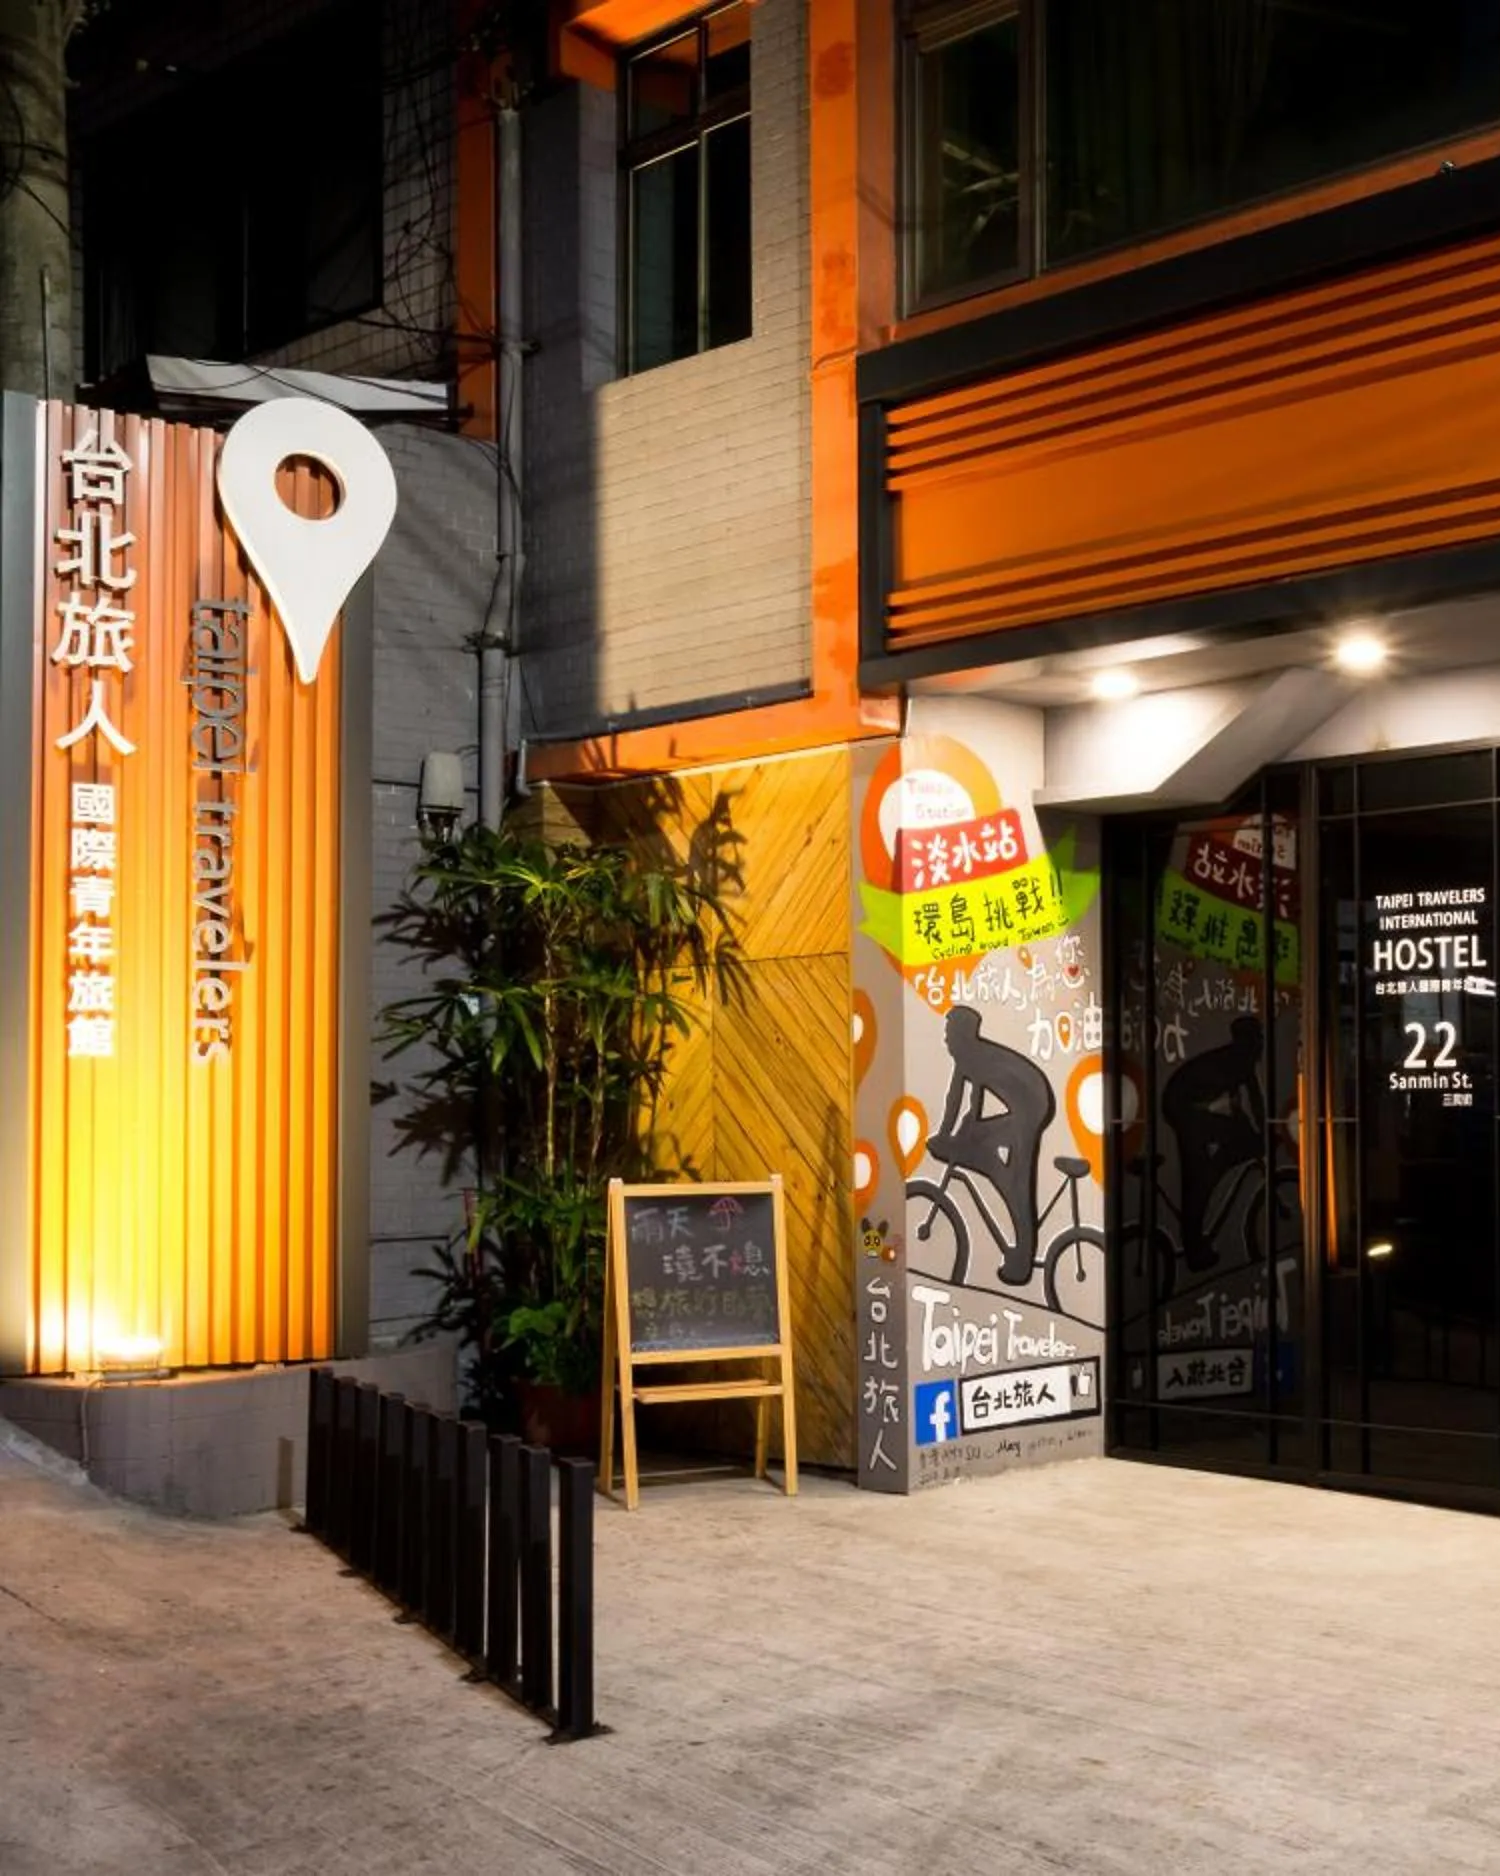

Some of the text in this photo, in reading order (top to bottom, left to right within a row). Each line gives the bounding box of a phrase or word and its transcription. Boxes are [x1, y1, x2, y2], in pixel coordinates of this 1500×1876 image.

[51, 428, 137, 1058] 台北旅人 國際青年旅館
[180, 598, 256, 1066] taipei travelers
[910, 818, 1019, 888] 淡水站
[1375, 888, 1486, 910] TAIPEI TRAVELERS
[1379, 910, 1479, 931] INTERNATIONAL
[1373, 934, 1487, 972] HOSTEL
[1403, 1020, 1457, 1068] 22
[1389, 1070, 1473, 1090] Sanmin St.
[911, 1284, 999, 1375] Taipei
[863, 1276, 900, 1472] 台北旅人
[971, 1378, 1057, 1419] 台北旅人
